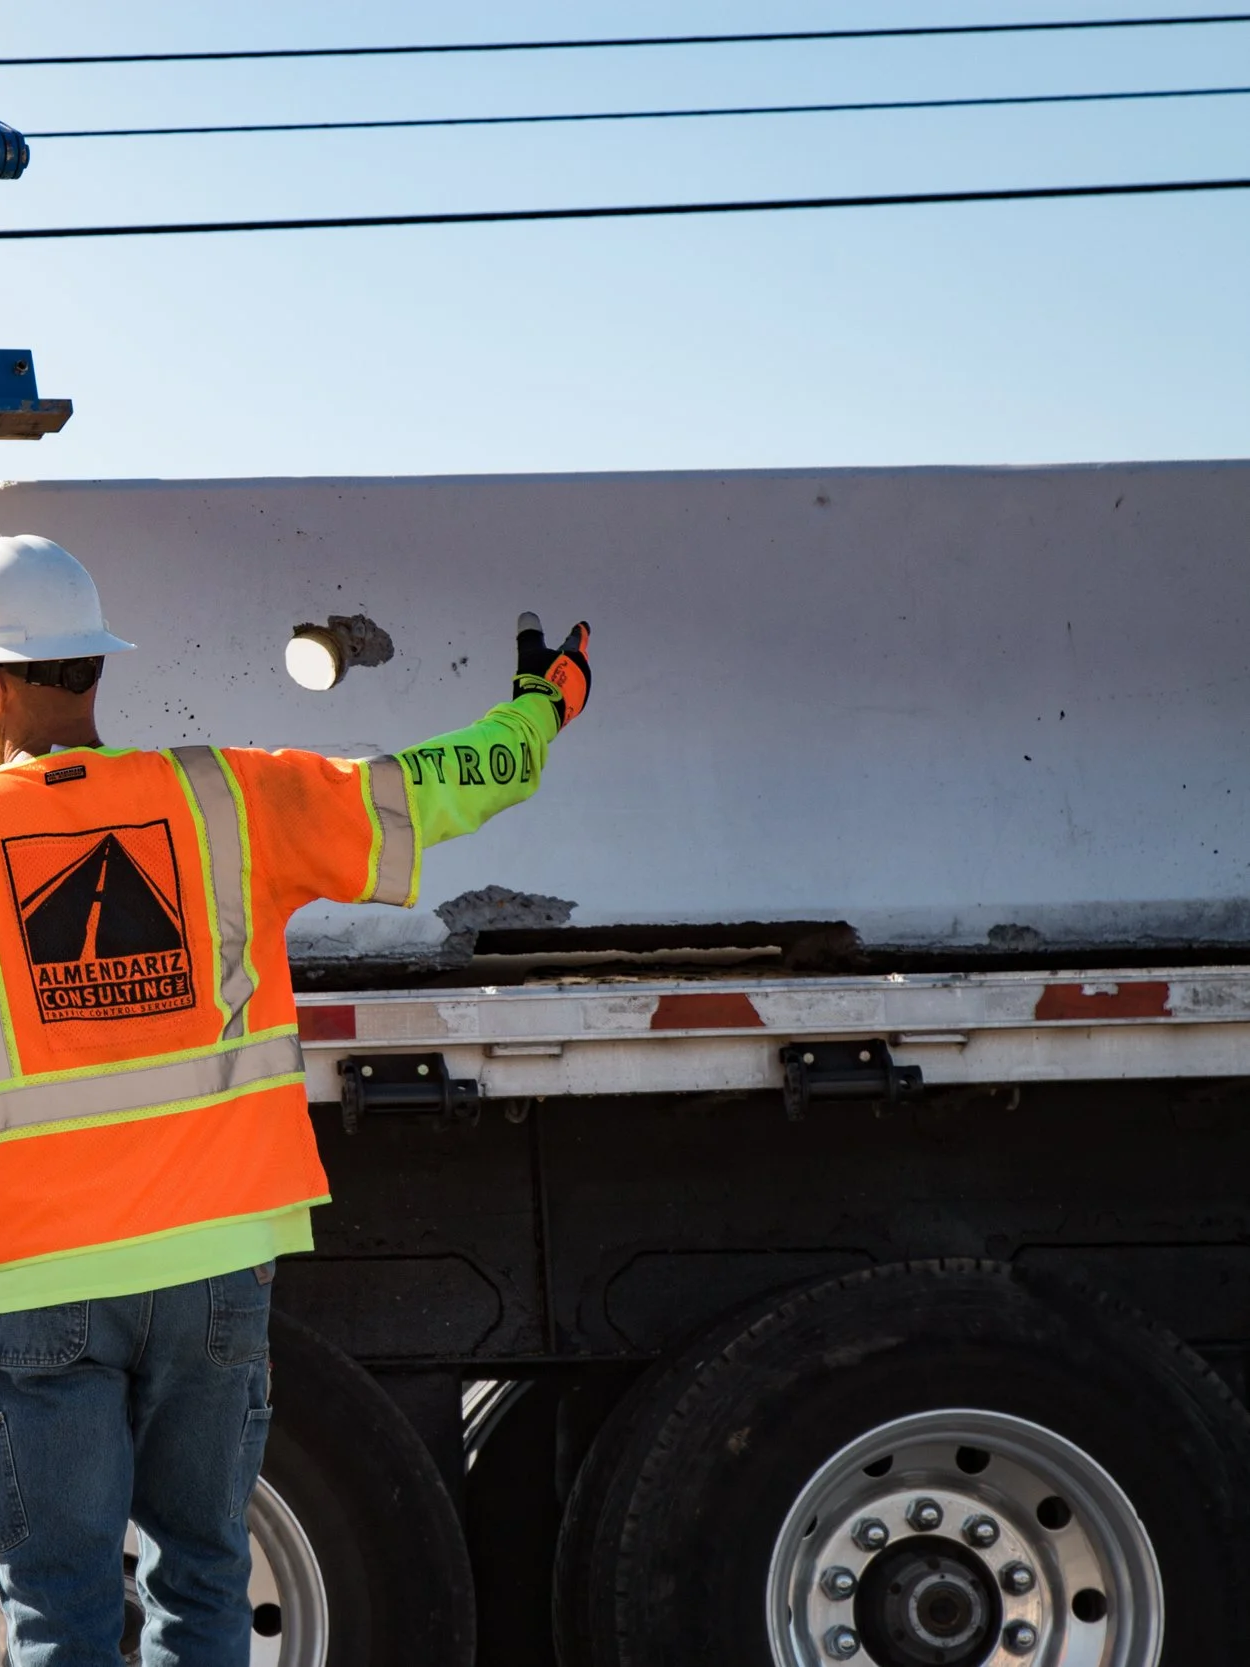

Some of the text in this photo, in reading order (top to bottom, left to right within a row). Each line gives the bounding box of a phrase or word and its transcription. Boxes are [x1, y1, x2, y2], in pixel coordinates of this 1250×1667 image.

[39, 952, 183, 986] ALMENDARIZ
[43, 979, 173, 1008] CONSULTING
[176, 975, 186, 993] INC
[45, 998, 192, 1020] TRAFFIC CONTROL SERVICES
